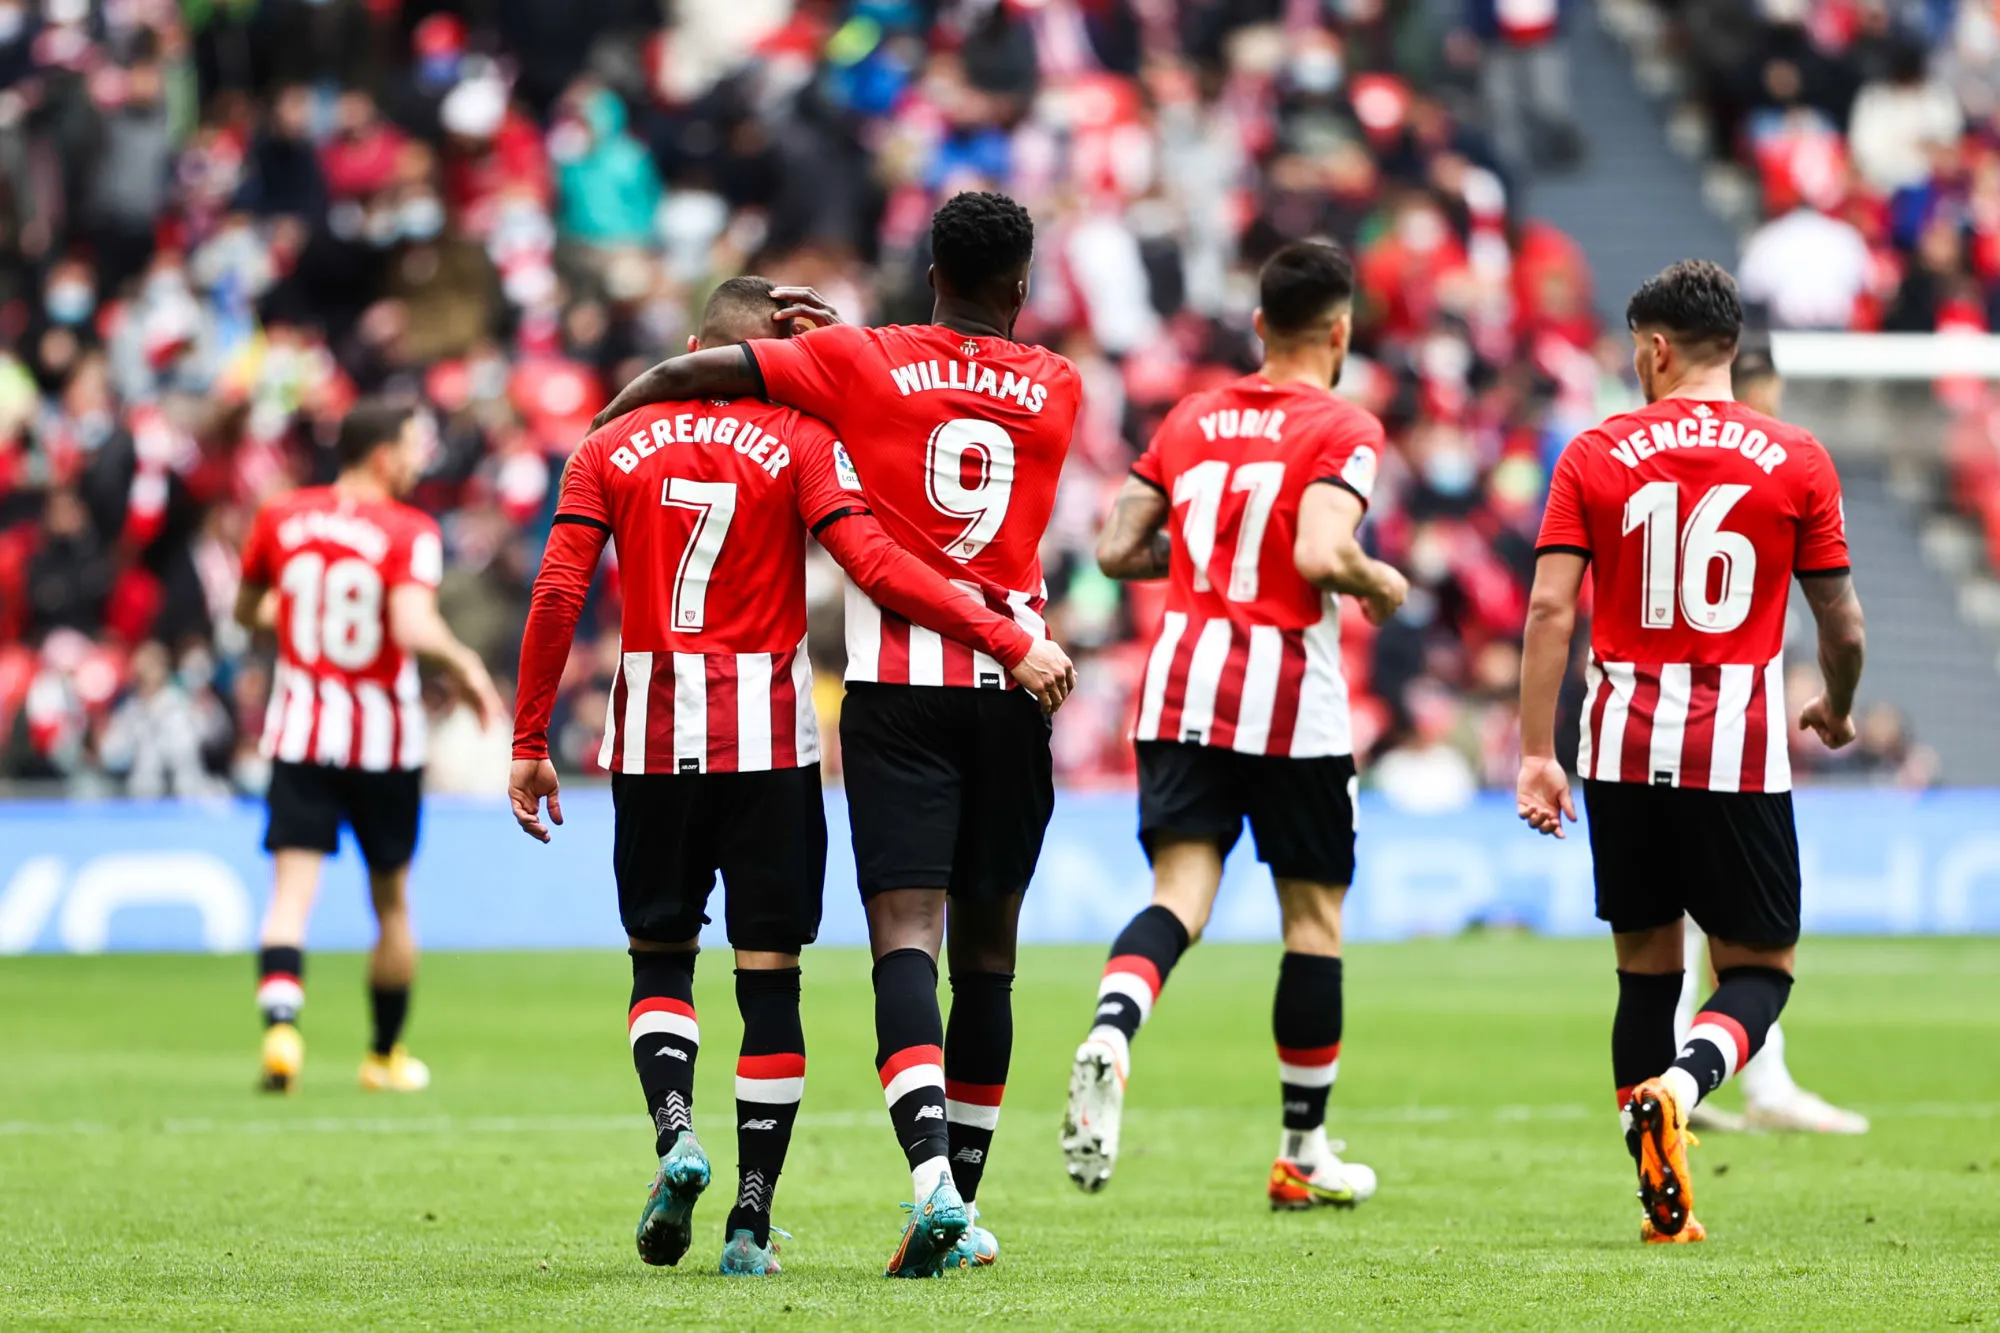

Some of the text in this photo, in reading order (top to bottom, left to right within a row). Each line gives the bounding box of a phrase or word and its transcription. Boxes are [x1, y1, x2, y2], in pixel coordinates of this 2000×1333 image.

[609, 413, 791, 479] BERENGUER
[890, 360, 1048, 413] WILLIAMS
[1609, 418, 1788, 475] VENCEDOR
[660, 477, 738, 633] 7
[925, 418, 1015, 564] 9
[1172, 459, 1286, 603] 17
[1622, 481, 1757, 634] 16
[280, 551, 383, 673] 18
